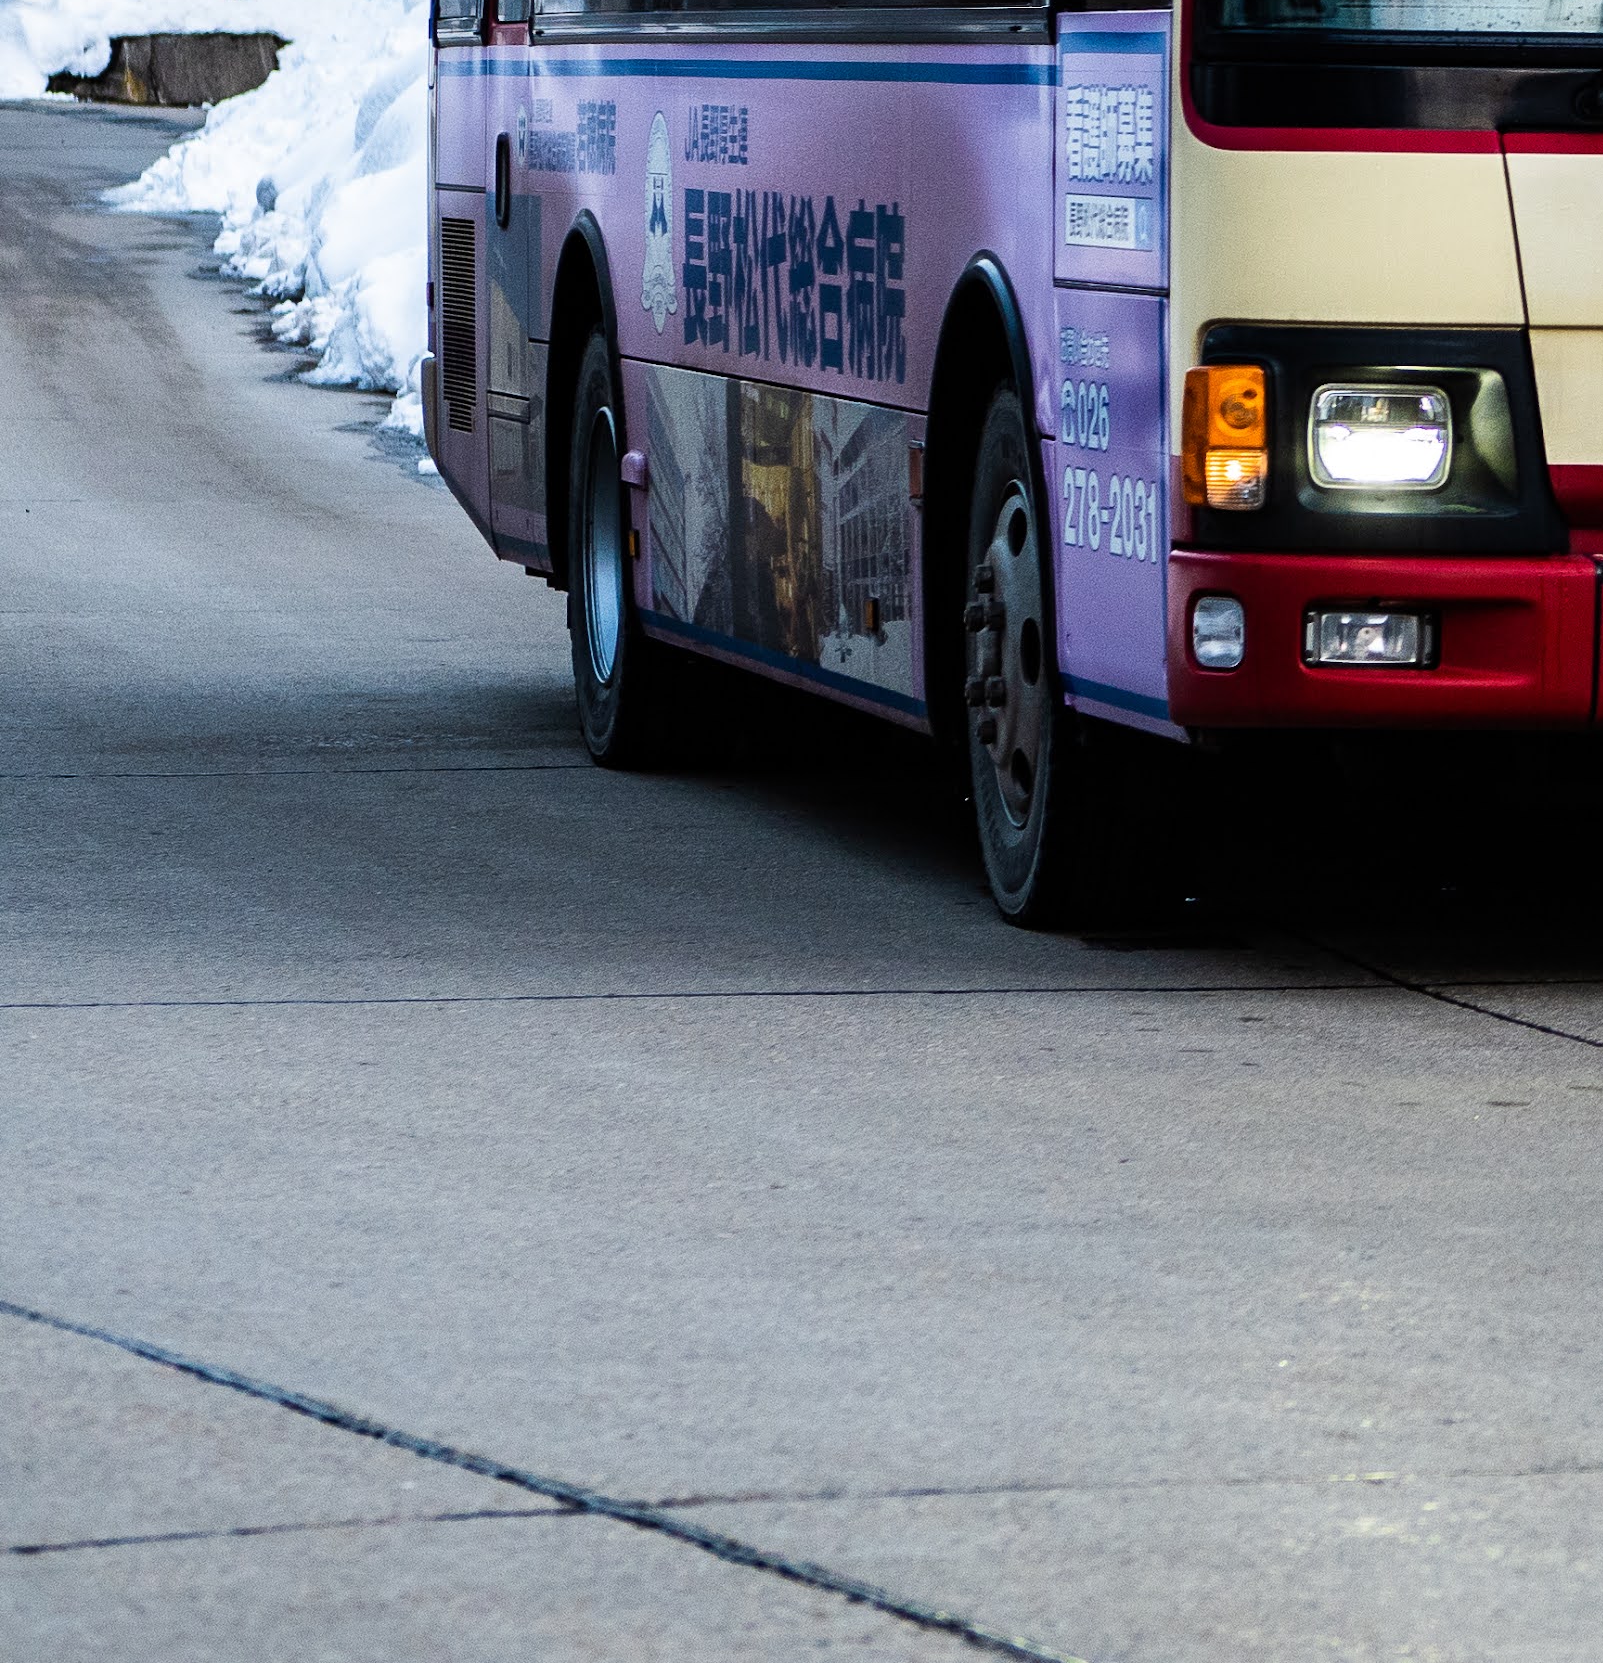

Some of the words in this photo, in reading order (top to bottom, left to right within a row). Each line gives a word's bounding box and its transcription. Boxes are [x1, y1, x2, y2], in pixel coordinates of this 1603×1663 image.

[682, 187, 907, 385] 長野松代総合病院
[1077, 379, 1110, 452] 026
[1063, 464, 1158, 565] 278-2031
